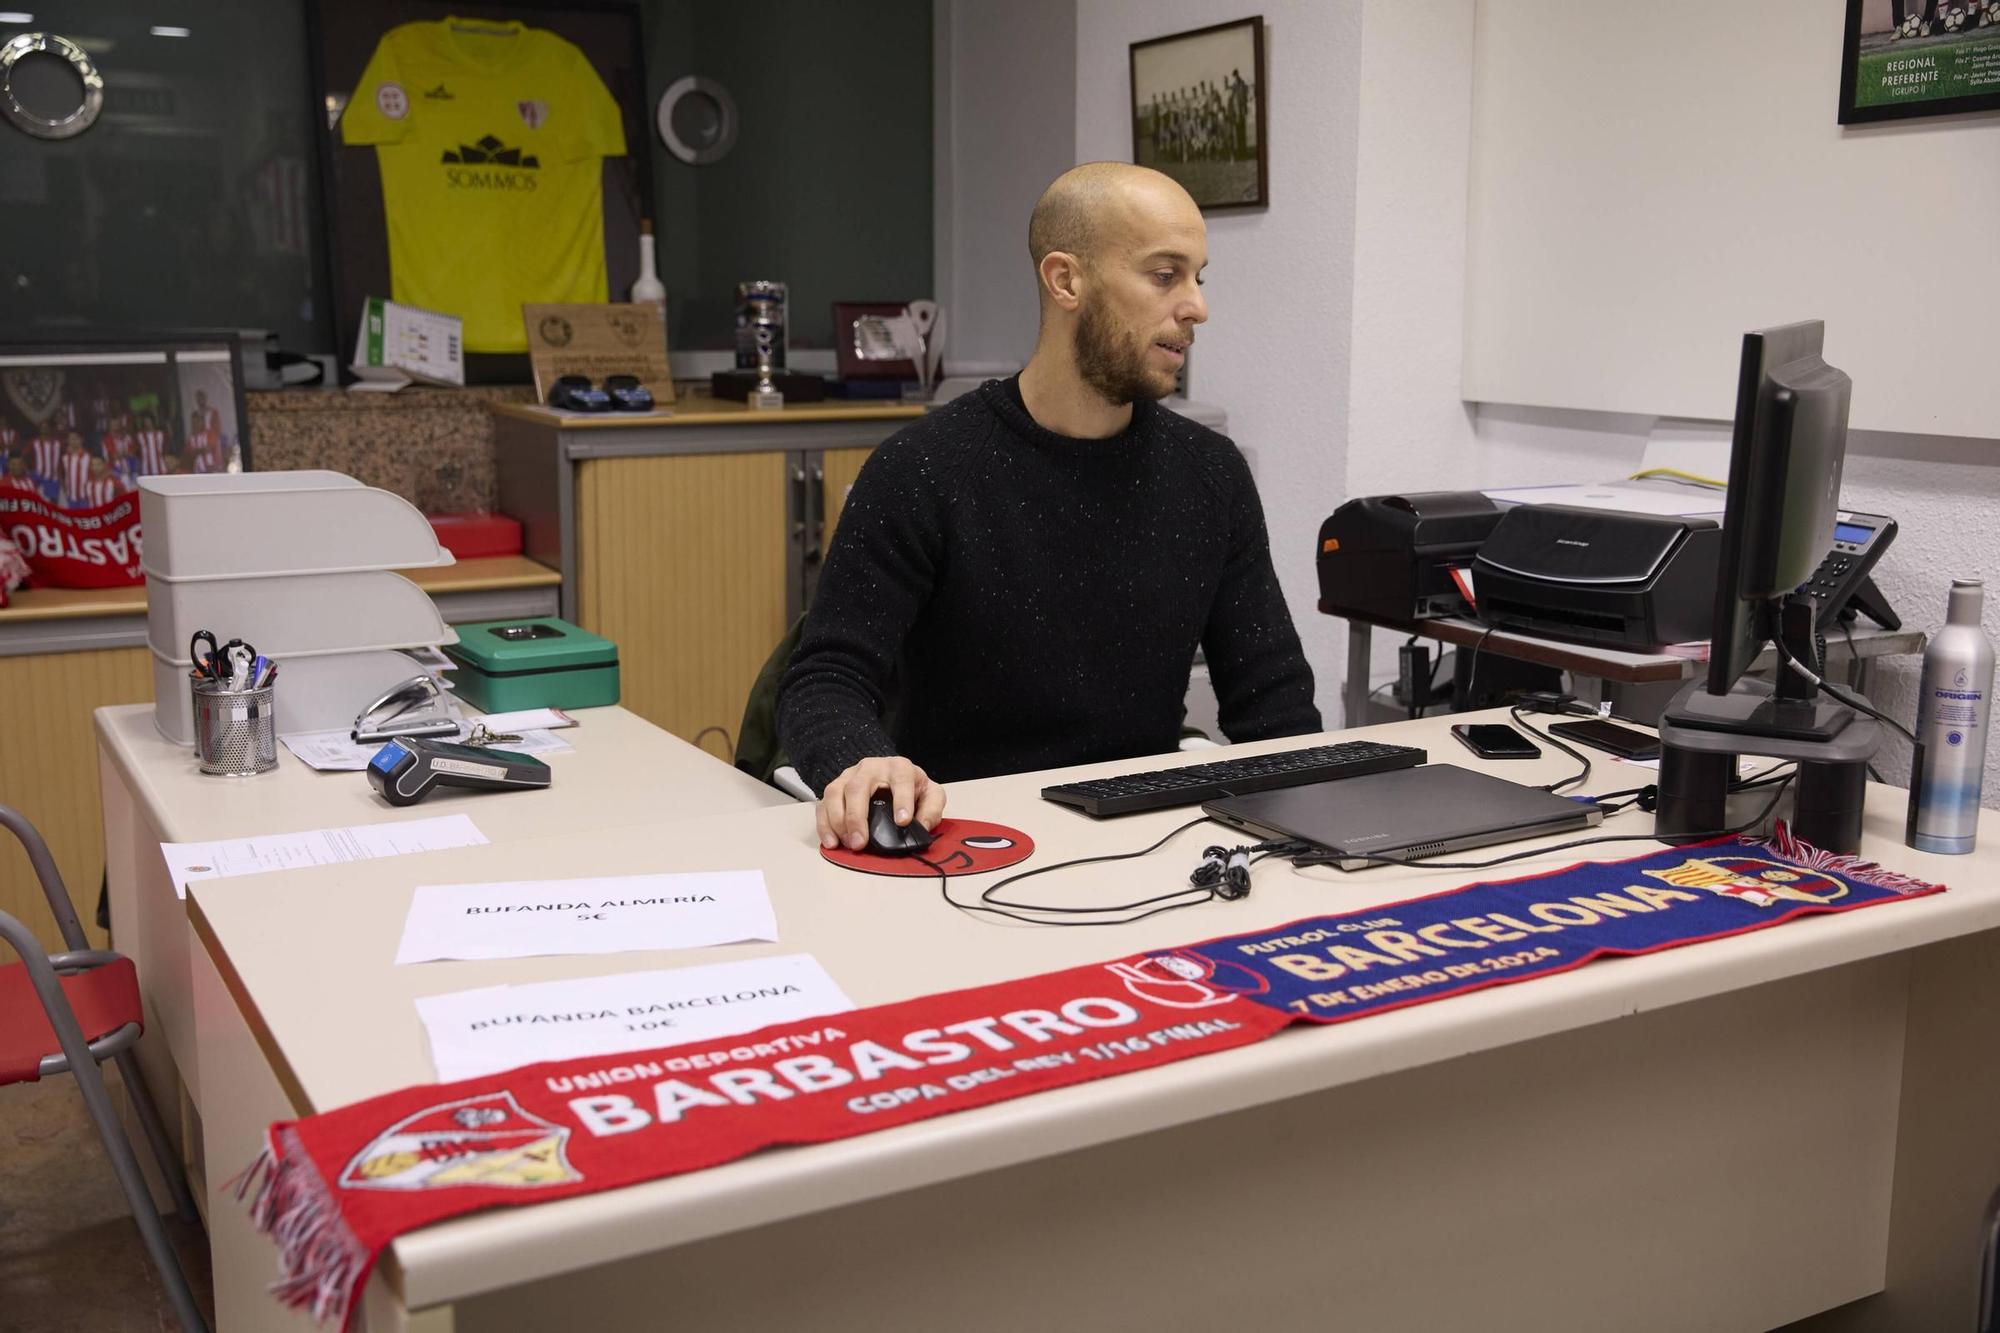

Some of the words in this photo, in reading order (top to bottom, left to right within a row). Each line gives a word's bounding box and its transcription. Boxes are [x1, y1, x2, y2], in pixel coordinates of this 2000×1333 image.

[1886, 56, 1936, 72] REGIONAL
[1881, 70, 1939, 87] PREFERENTE
[1891, 86, 1920, 97] (GRUPO
[447, 169, 538, 192] SOMMOS
[1935, 691, 1982, 700] ORIGEN
[466, 902, 591, 914] BUFANDA
[600, 894, 716, 907] ALMERÍA
[577, 912, 607, 921] 5€
[1238, 928, 1339, 956] FUTBOL
[1336, 917, 1403, 933] CLUB
[1267, 884, 1700, 982] BARCELONA
[1289, 999, 1309, 1015] 7
[1308, 990, 1356, 1008] DE
[1348, 971, 1450, 1001] ENERO
[1447, 962, 1485, 979] DE
[1480, 946, 1560, 971] 2024
[470, 1009, 617, 1031] BUFANDA
[626, 984, 802, 1016] BARCELONA
[625, 1018, 679, 1032] 10€
[546, 1061, 664, 1093] UNION
[664, 1027, 847, 1072] DEPORTIVA
[568, 996, 1140, 1138] BARBASTRO
[847, 1082, 948, 1113] COPA
[946, 1063, 1016, 1091] DEL
[1012, 1050, 1076, 1072] REY
[1079, 1037, 1151, 1061] 1/16
[1146, 1018, 1242, 1046] FINAL
